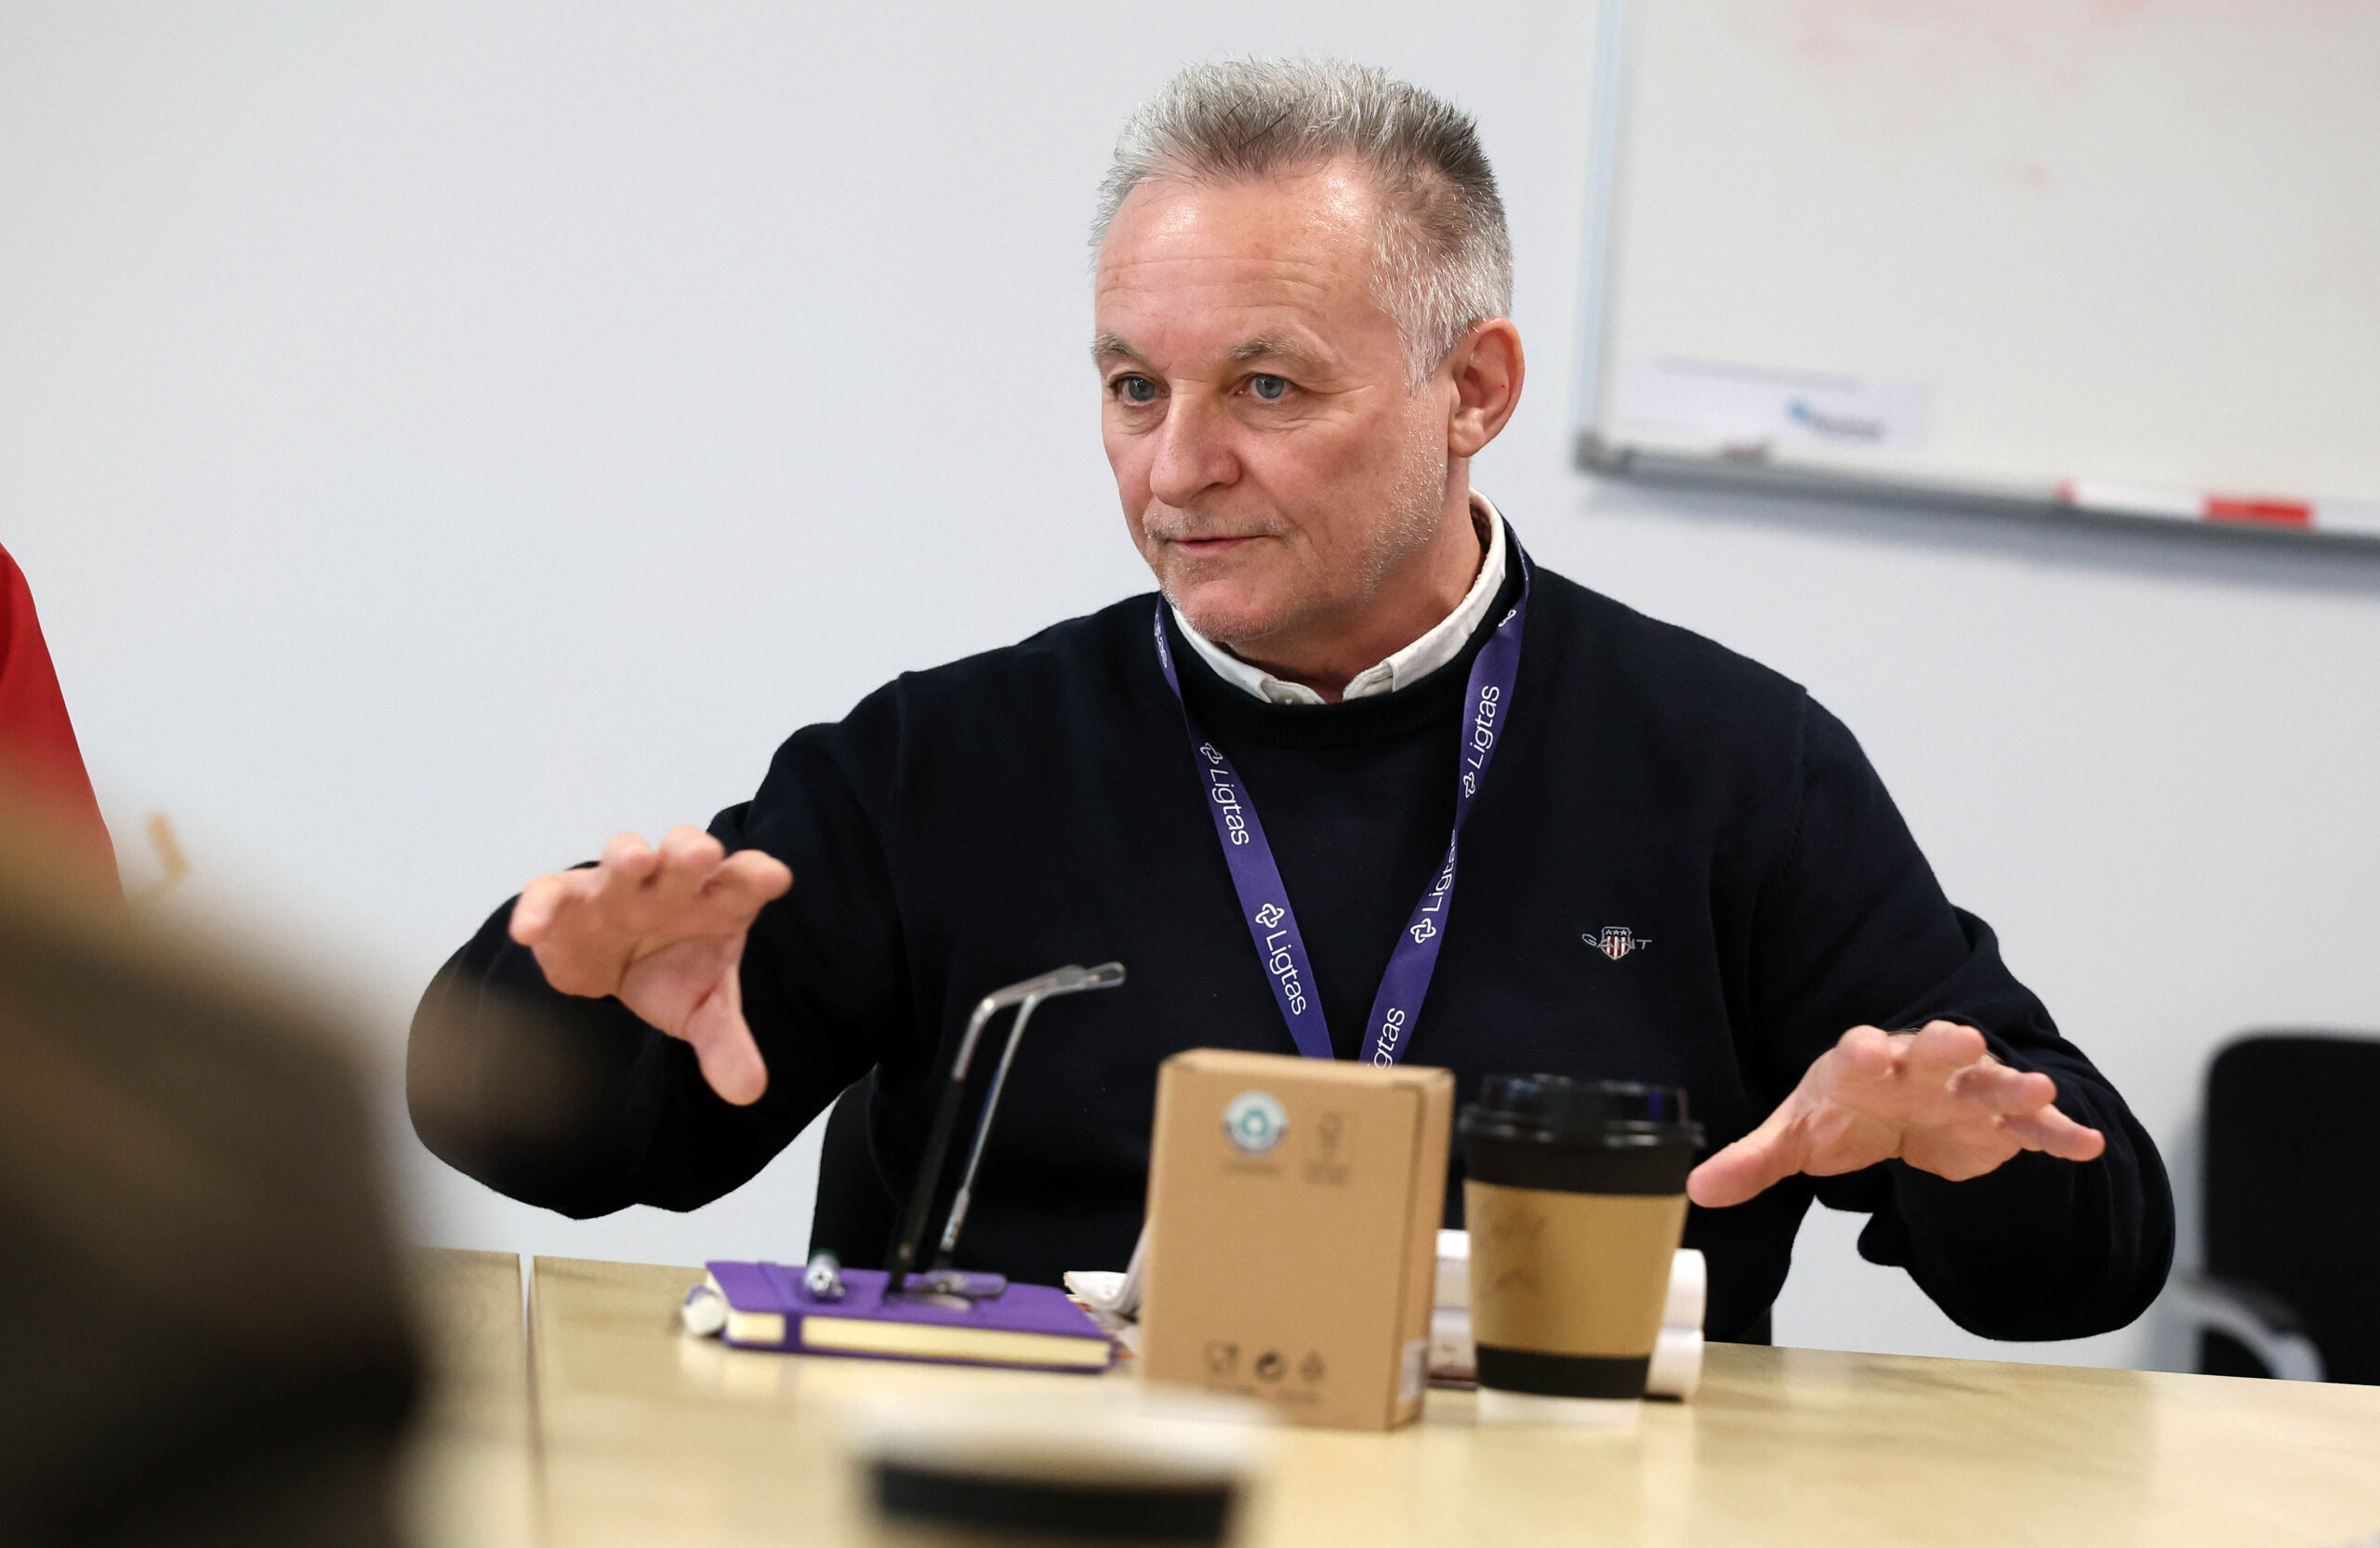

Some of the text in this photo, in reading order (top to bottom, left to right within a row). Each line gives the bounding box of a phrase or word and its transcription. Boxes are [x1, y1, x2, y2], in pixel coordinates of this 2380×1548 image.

[1467, 685, 1500, 770] Ligtas
[1210, 768, 1250, 846] Ligtas
[1265, 929, 1307, 1016] Ligtas
